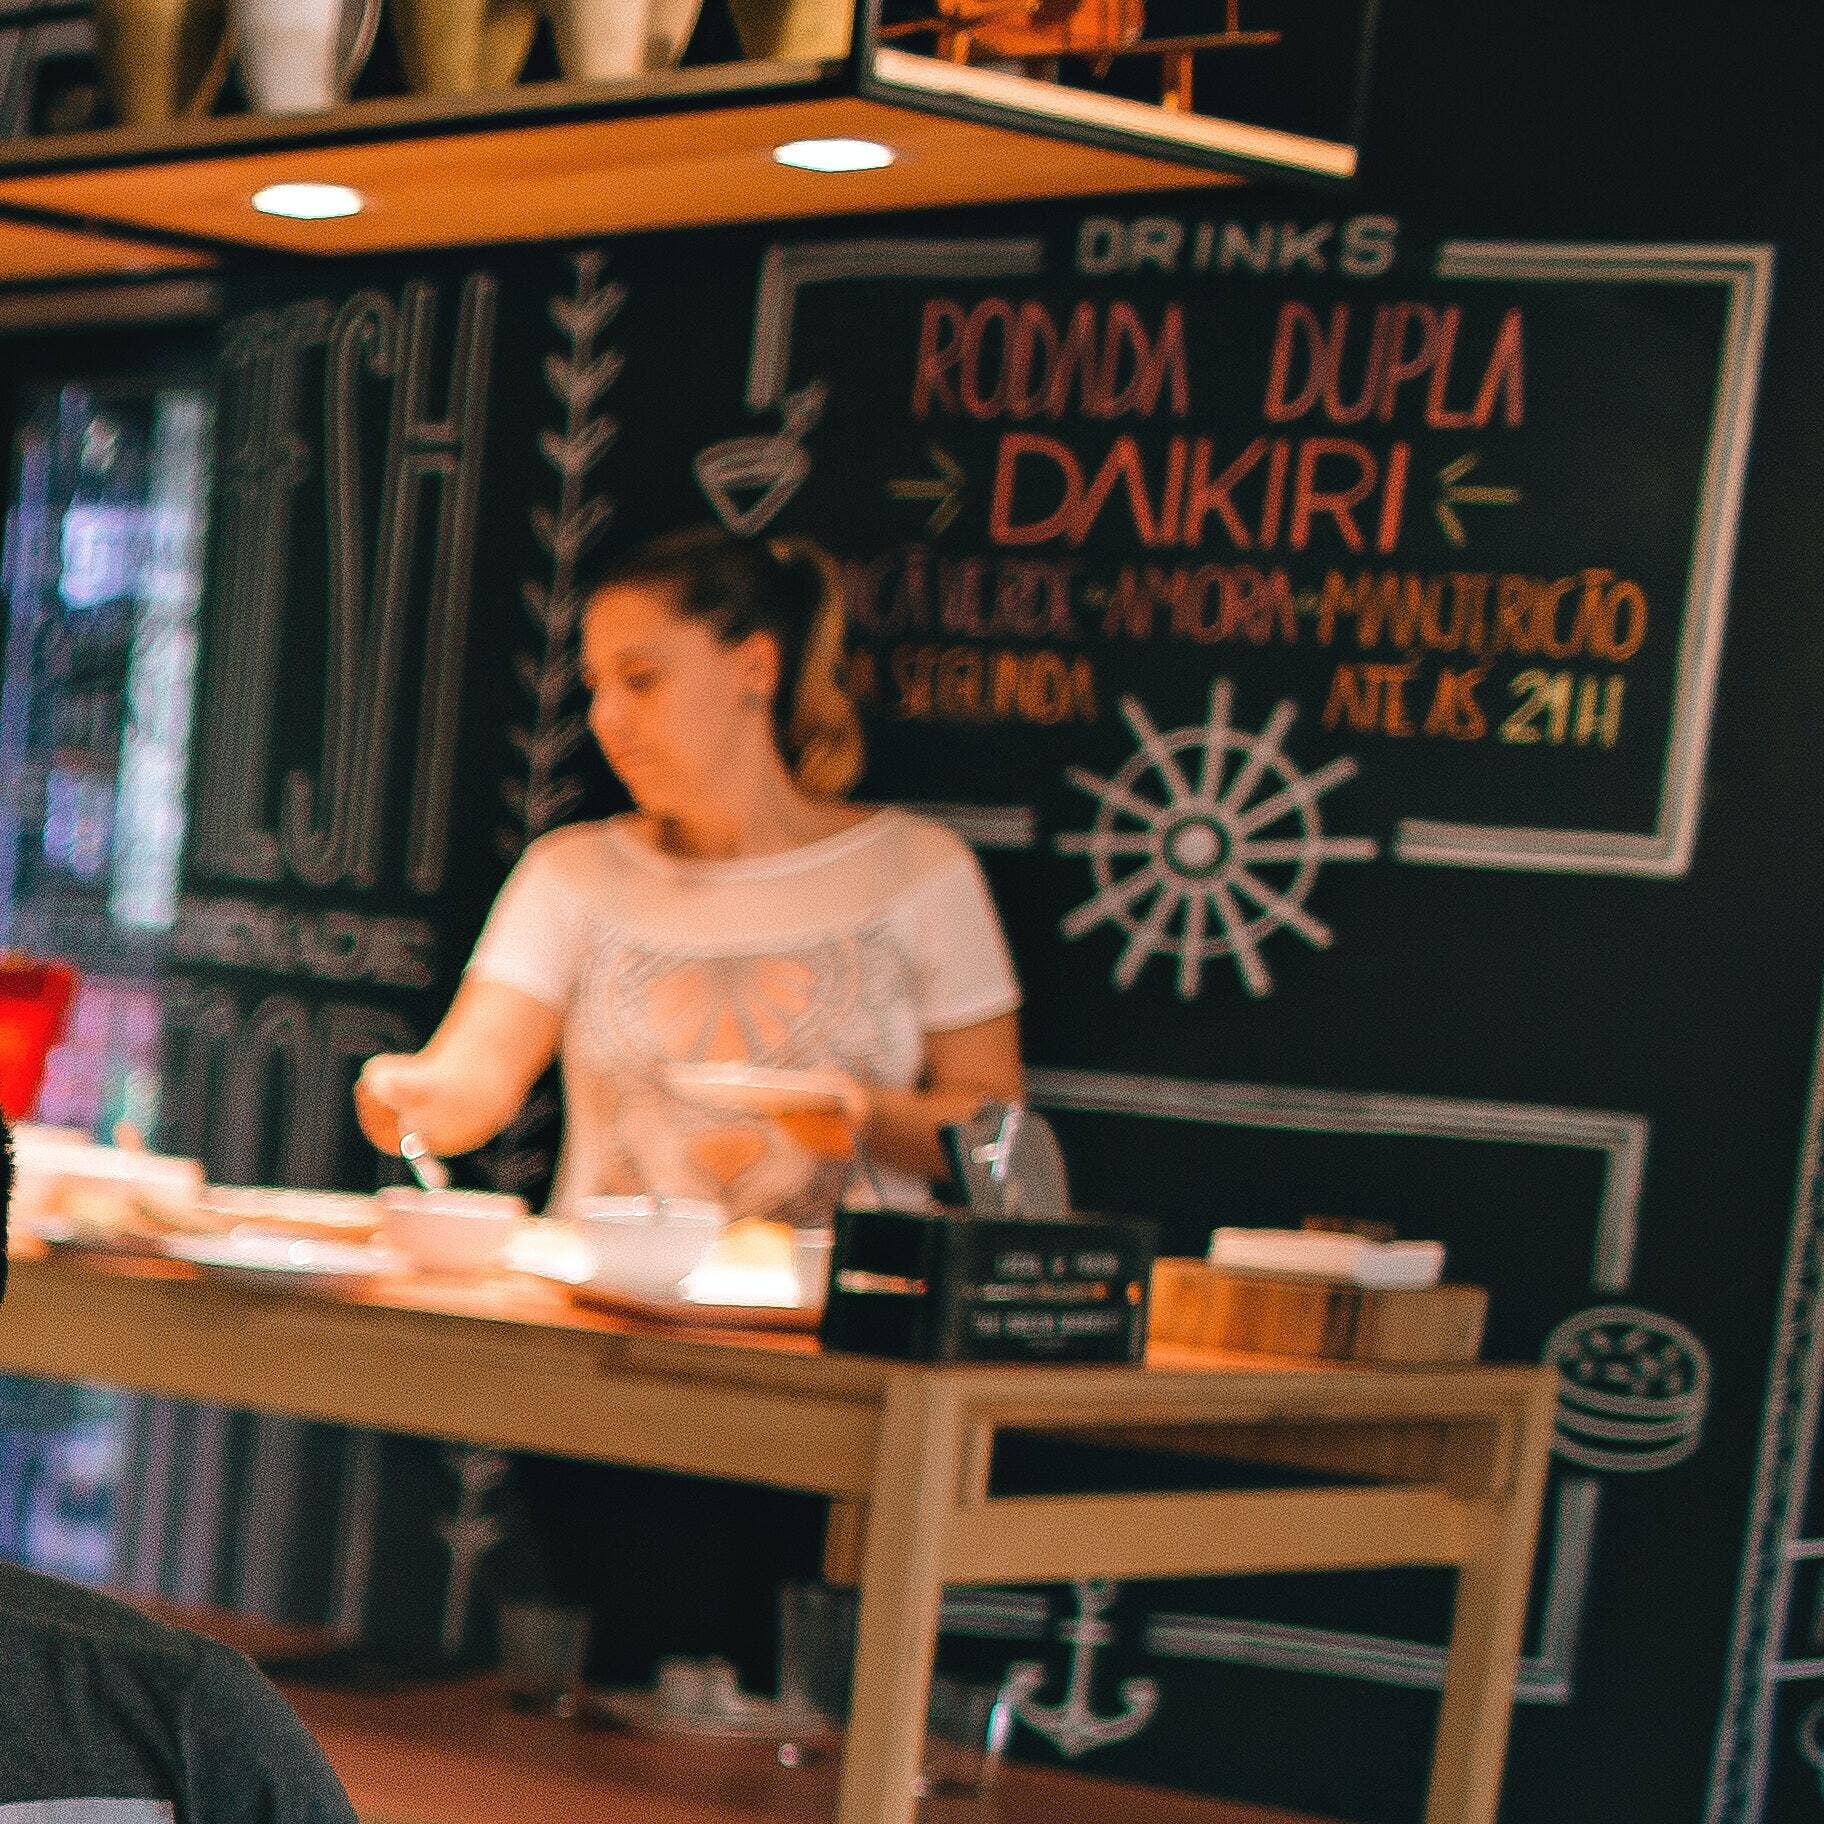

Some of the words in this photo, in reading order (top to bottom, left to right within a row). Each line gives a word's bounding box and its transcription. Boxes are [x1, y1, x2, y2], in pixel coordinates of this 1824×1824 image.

[1074, 215, 1400, 276] DRINKS
[912, 298, 1190, 420] RODADA
[1264, 304, 1526, 428] DUPLA
[990, 434, 1412, 552] DAIKIRI
[1498, 668, 1626, 748] 21H
